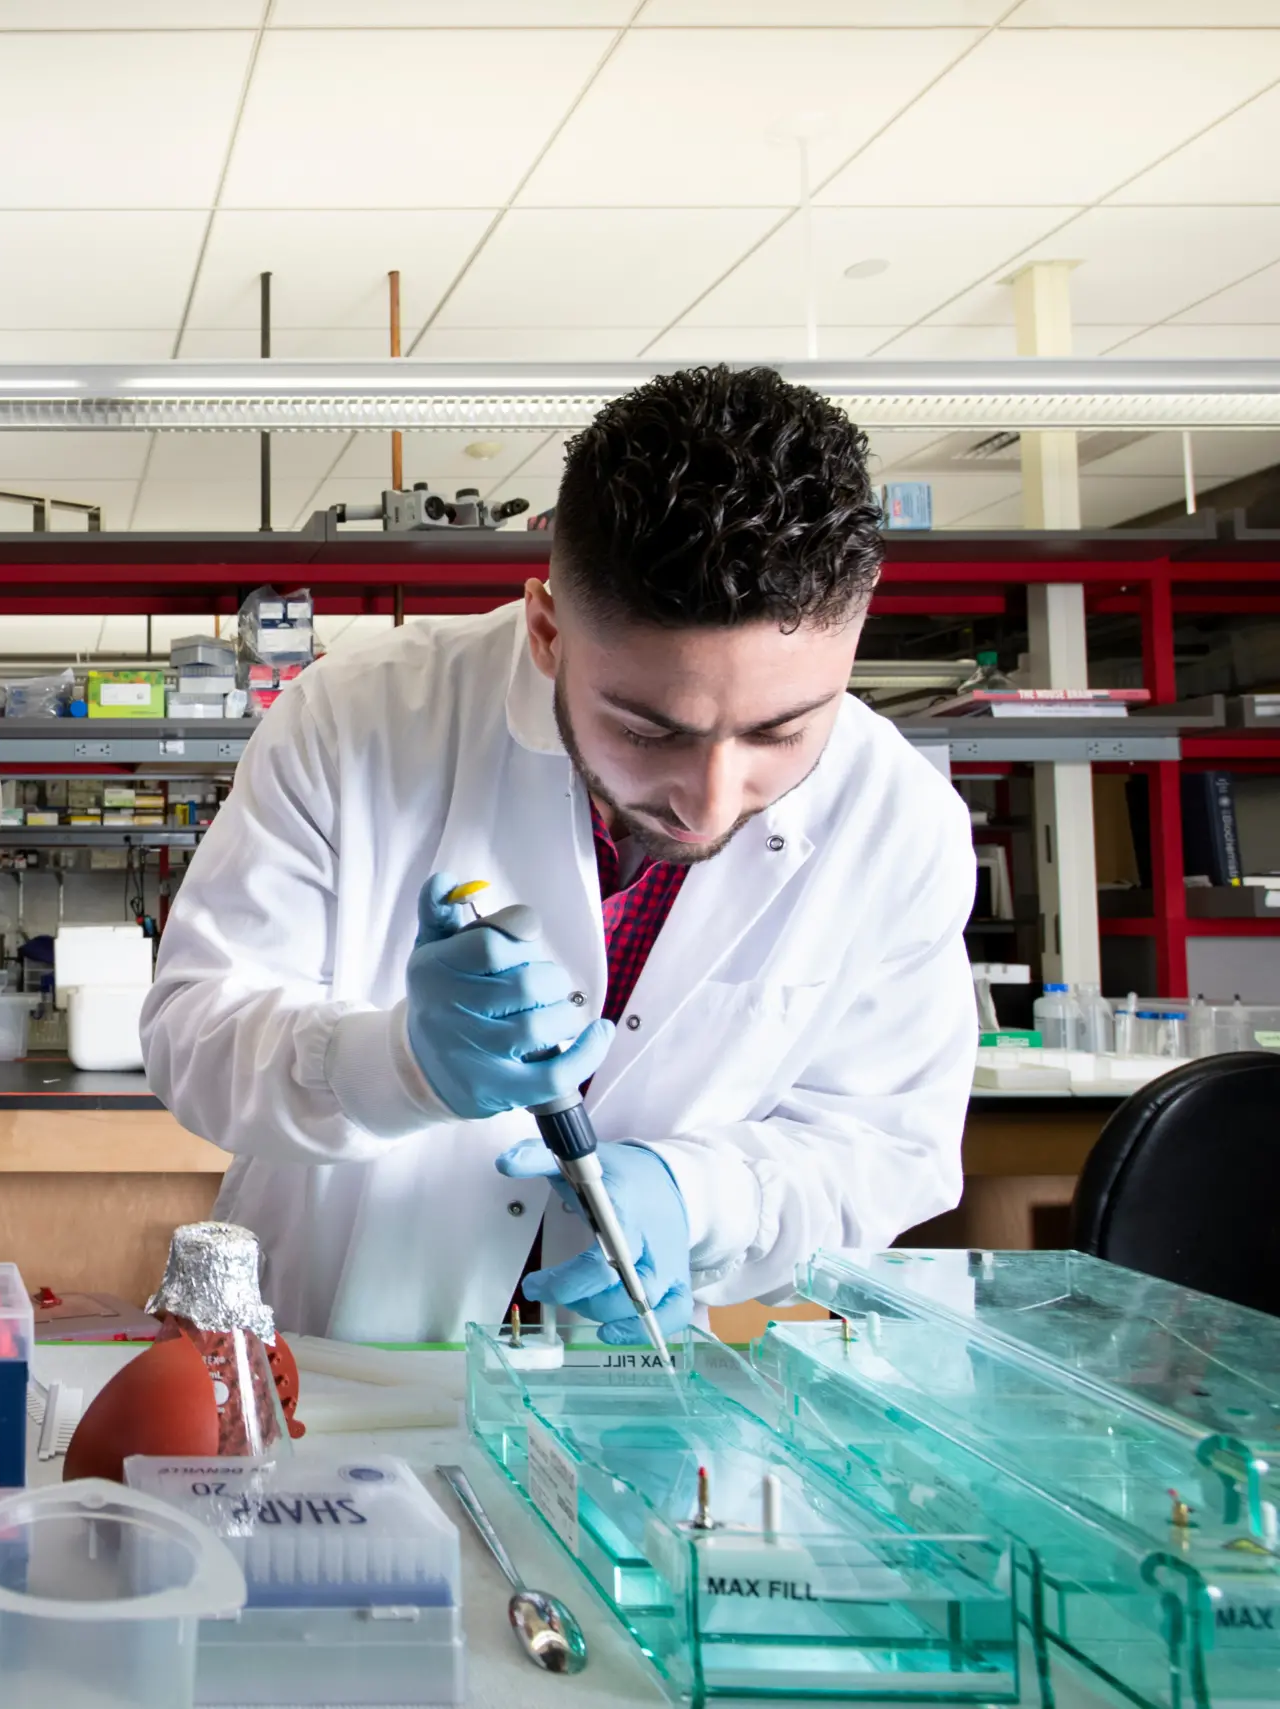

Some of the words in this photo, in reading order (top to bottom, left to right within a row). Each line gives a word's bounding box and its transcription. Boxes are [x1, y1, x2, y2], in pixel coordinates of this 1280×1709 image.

[191, 1482, 229, 1497] 20
[707, 1576, 761, 1598] MAX
[769, 1579, 819, 1601] FILL
[1216, 1605, 1275, 1631] MAX
